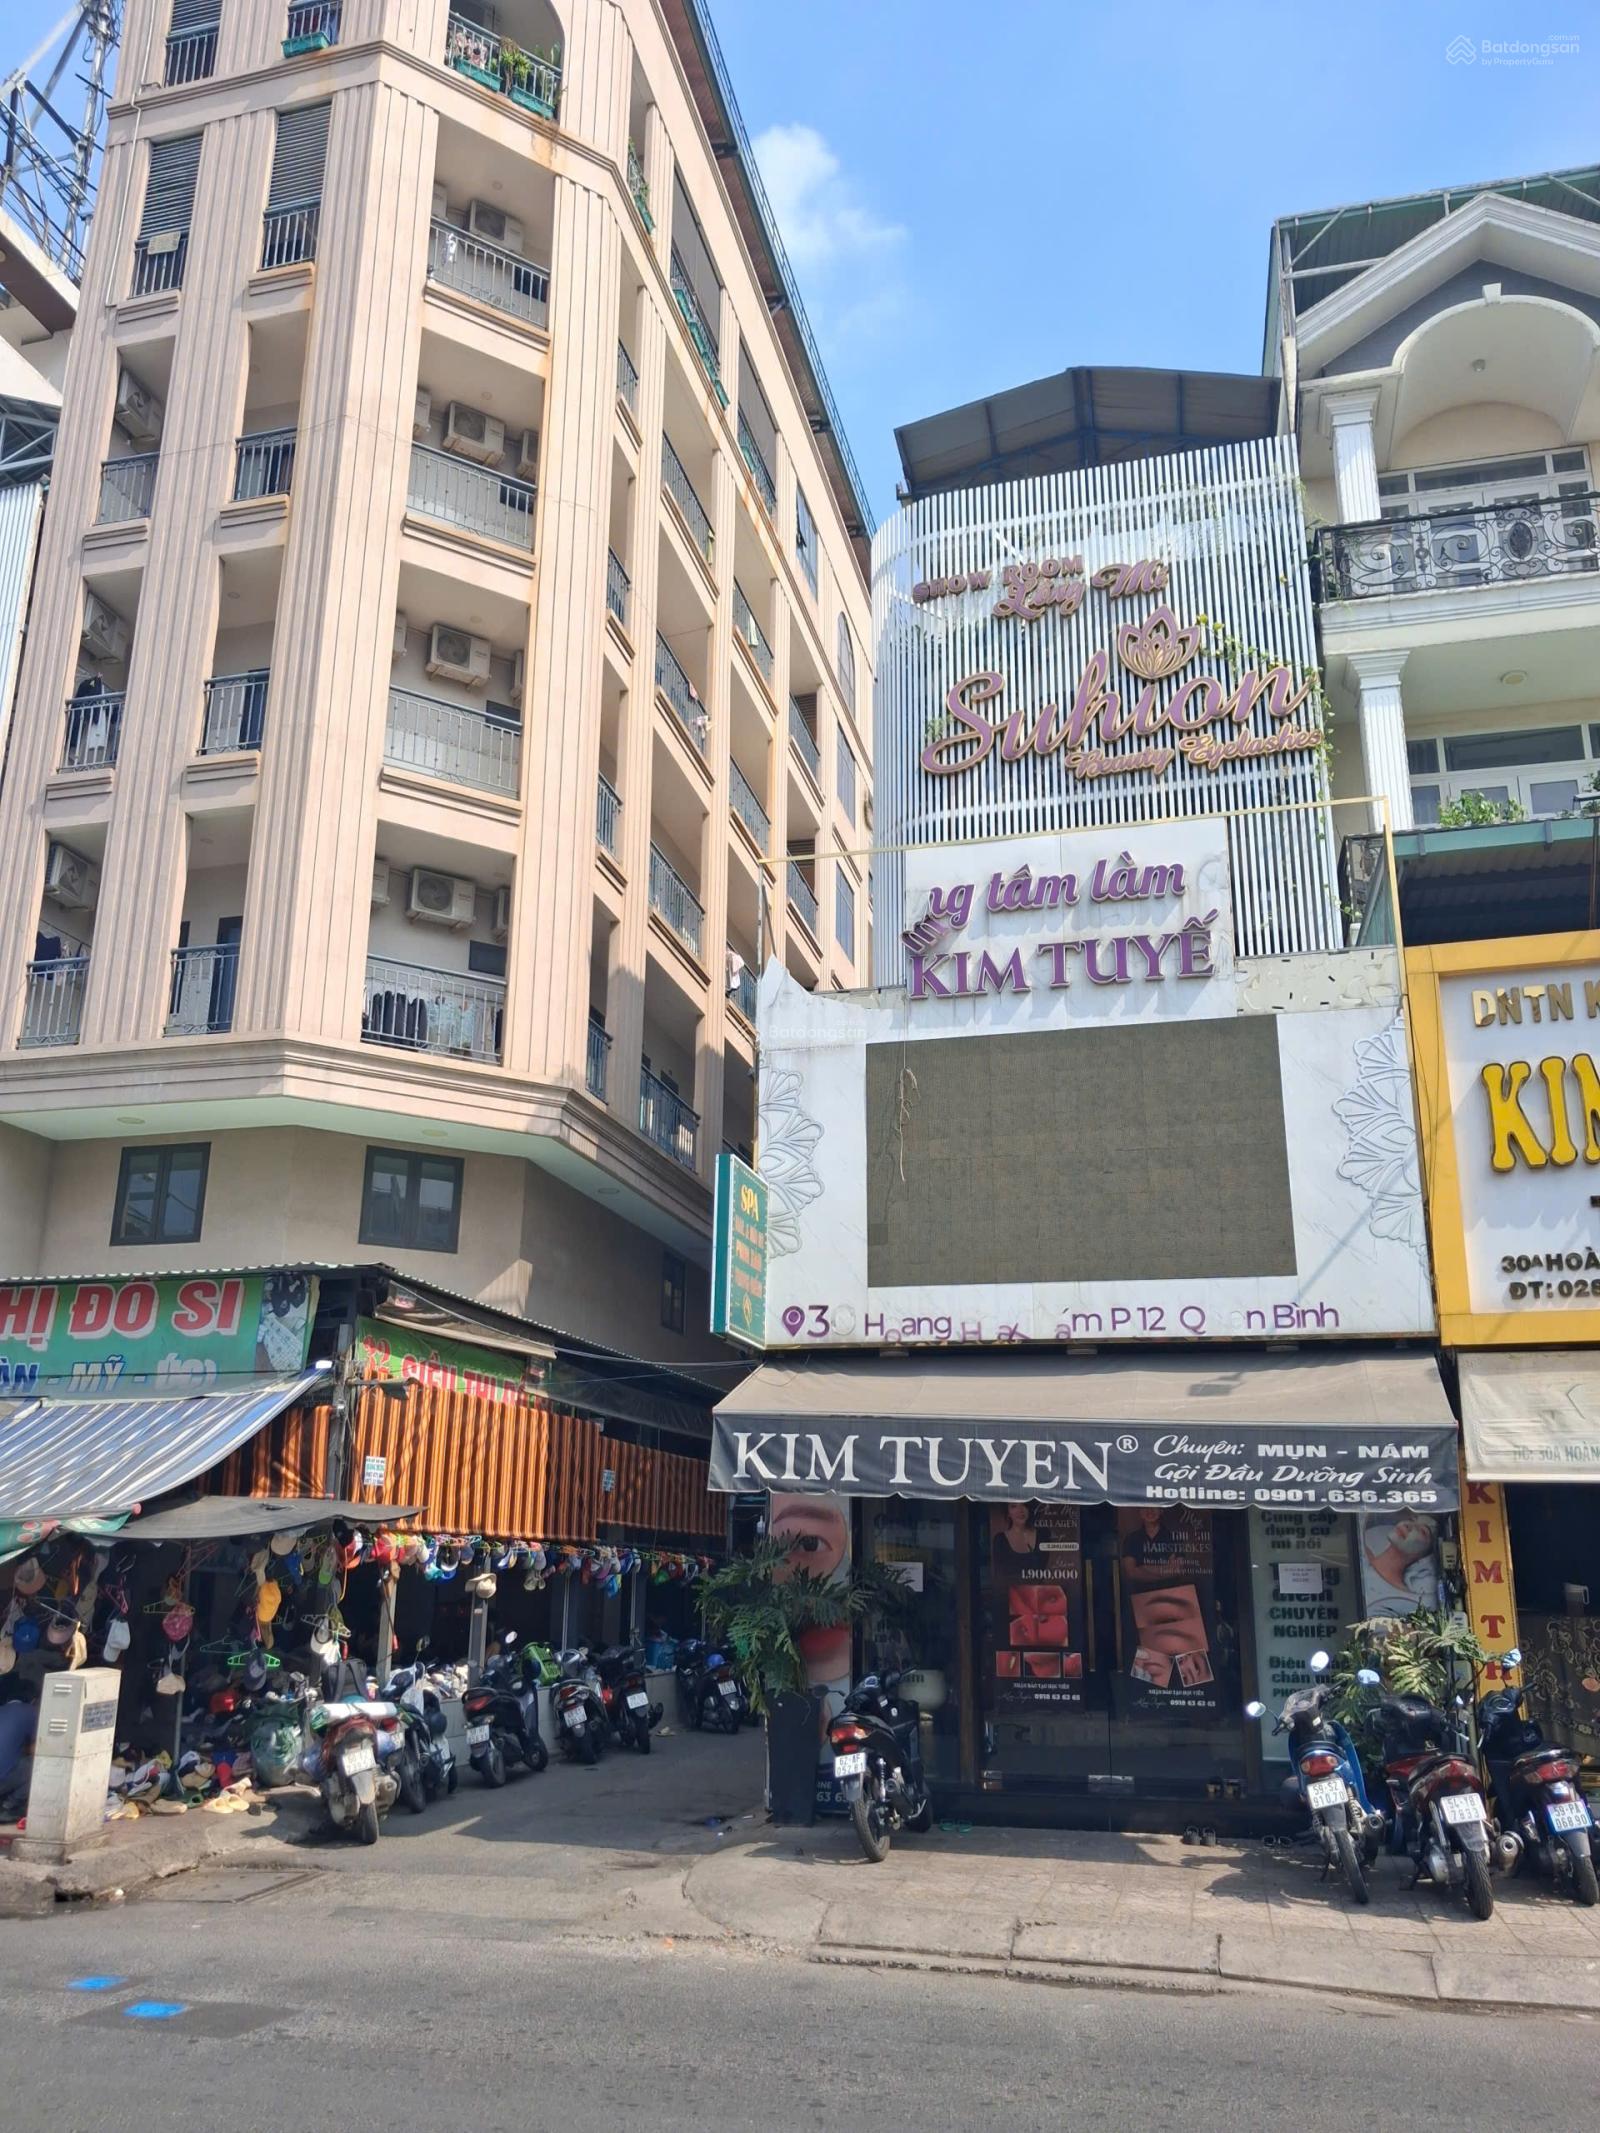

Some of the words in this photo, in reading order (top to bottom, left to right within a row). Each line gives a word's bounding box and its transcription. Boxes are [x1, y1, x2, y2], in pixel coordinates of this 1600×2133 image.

[920, 649, 1317, 777] Suhion
[1065, 746, 1176, 779] Beauty
[1179, 722, 1322, 771] Eyelashes
[986, 863, 1080, 914] tâm
[1090, 849, 1187, 904] làm
[908, 945, 1033, 1001] KIM
[741, 1183, 759, 1222] SPA
[172, 1279, 245, 1338] SI
[732, 1431, 860, 1483] KIM
[1153, 1434, 1245, 1463] Chuyên:
[1257, 1444, 1328, 1460] MỤN
[1154, 1462, 1199, 1484] Gội
[1204, 1463, 1264, 1482] Đầu
[1271, 1465, 1366, 1488] Dưỡng
[1372, 1465, 1433, 1485] Sinh
[1145, 1485, 1246, 1501] Hotline:
[1254, 1488, 1438, 1504] 0901.636.365
